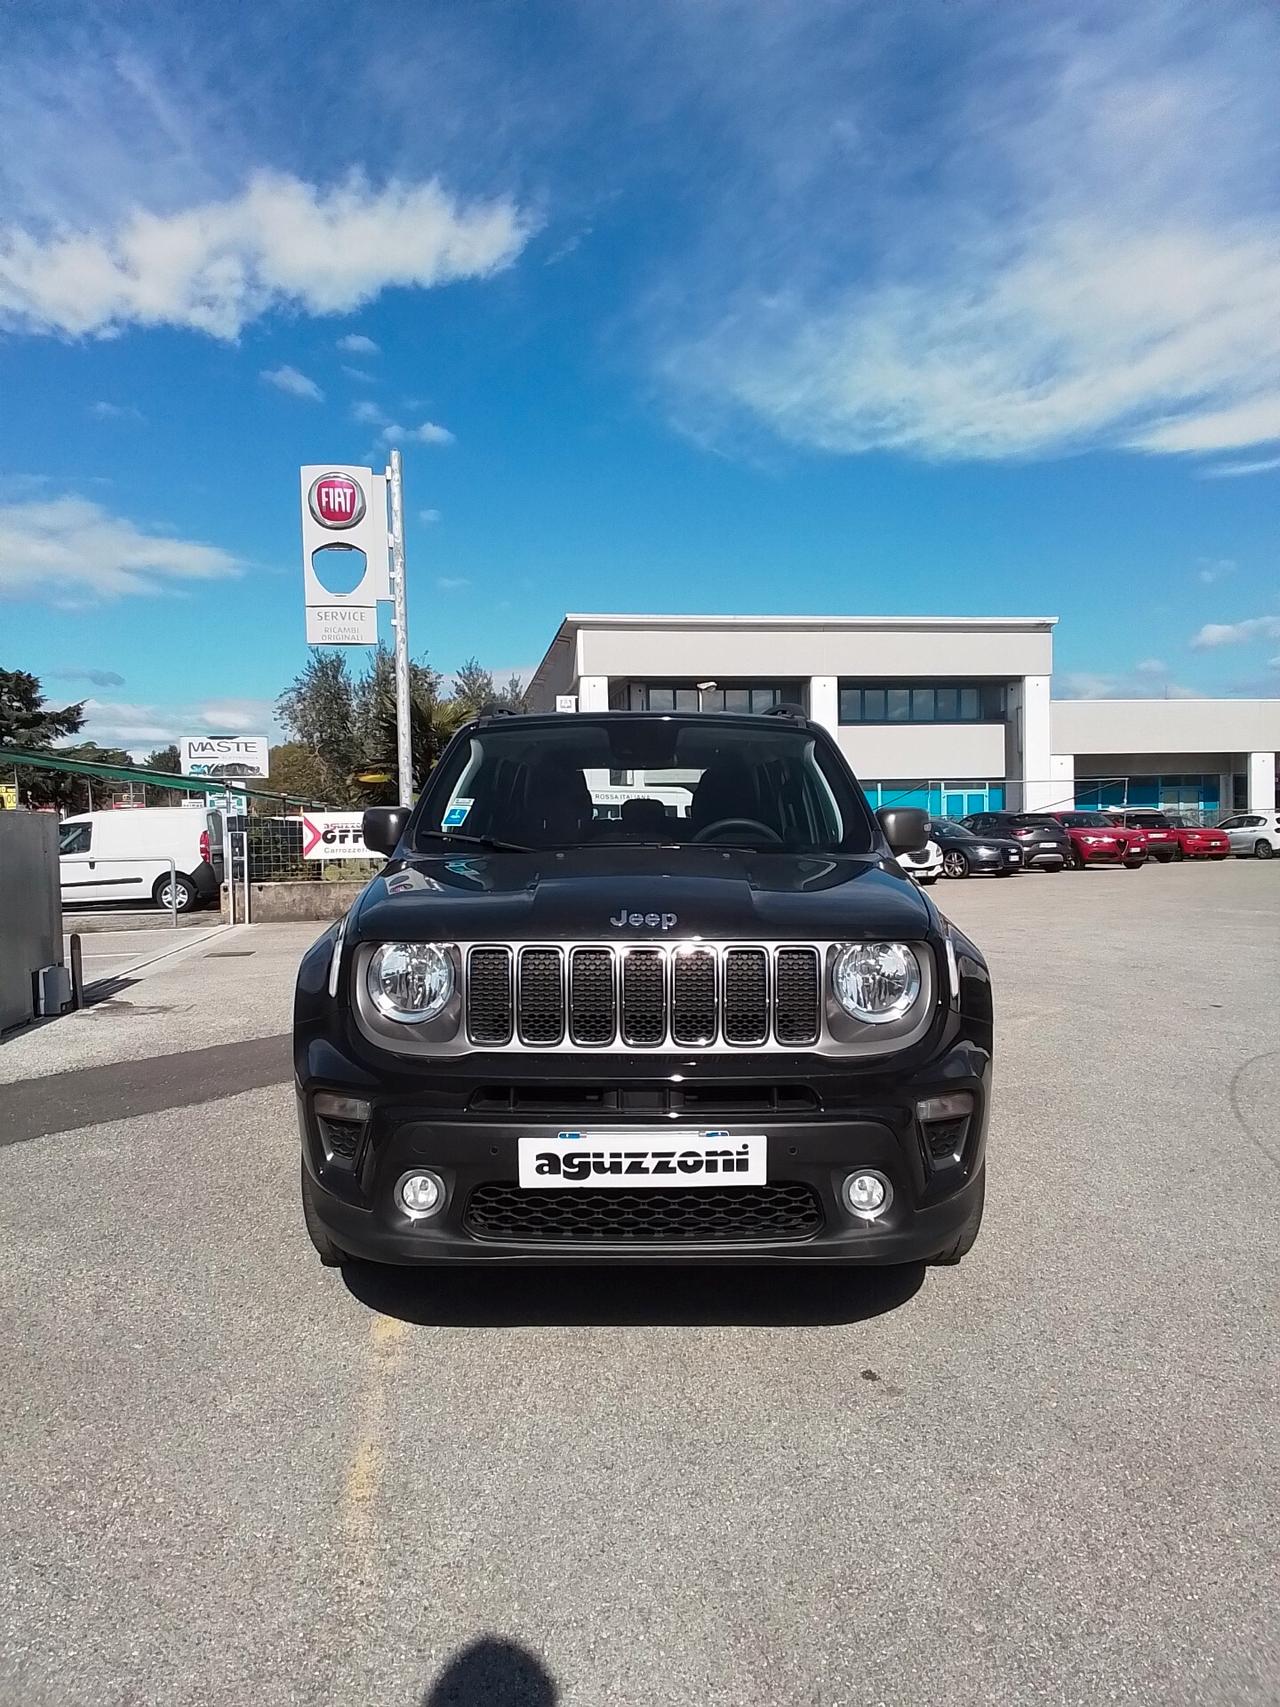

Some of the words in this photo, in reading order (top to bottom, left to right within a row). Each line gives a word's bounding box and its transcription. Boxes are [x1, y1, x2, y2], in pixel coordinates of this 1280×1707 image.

[321, 487, 353, 512] FIAT
[317, 611, 366, 621] SERVICE
[324, 626, 359, 634] RICAMBI
[610, 909, 678, 930] Jeep
[535, 1143, 749, 1180] aguzzoni
